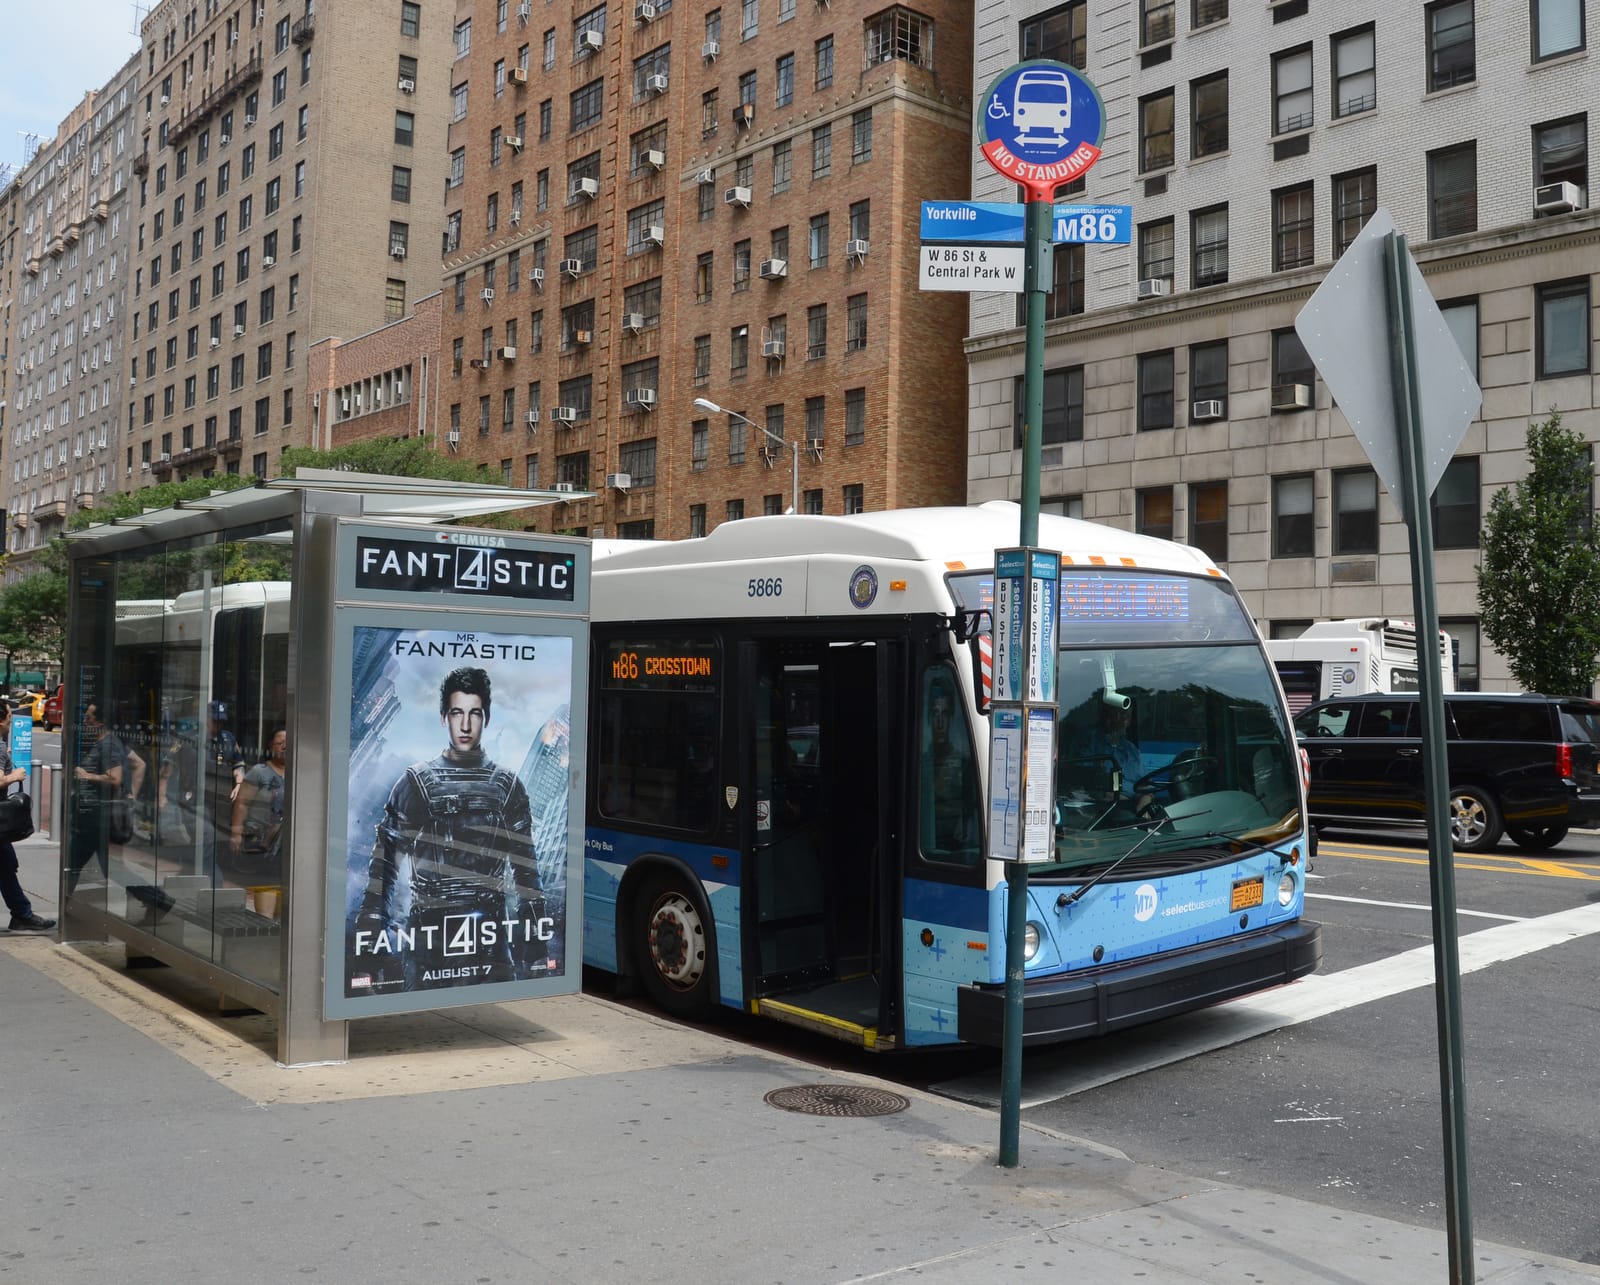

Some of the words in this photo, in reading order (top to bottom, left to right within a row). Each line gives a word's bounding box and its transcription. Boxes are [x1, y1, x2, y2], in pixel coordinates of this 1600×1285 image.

[991, 145, 1014, 169] NO
[1015, 146, 1093, 181] STANDING
[926, 207, 977, 221] Yorkville
[1057, 214, 1117, 241] M86
[928, 250, 941, 262] W
[944, 250, 958, 262] 86
[963, 250, 975, 262] St
[978, 251, 988, 262] &
[928, 265, 970, 278] Central
[974, 266, 1000, 279] Park
[1004, 267, 1016, 279] W
[451, 533, 506, 547] CEMUSA
[747, 577, 783, 597] 5866
[456, 633, 479, 642] MR.
[395, 640, 536, 660] FANTASTIC
[997, 621, 1005, 697] STATION
[612, 652, 638, 679] M86
[645, 656, 711, 676] CROSSTOWN
[1030, 621, 1038, 698] STATION
[602, 841, 613, 851] Bus
[422, 966, 480, 982] AUGUST
[482, 965, 492, 975] 7
